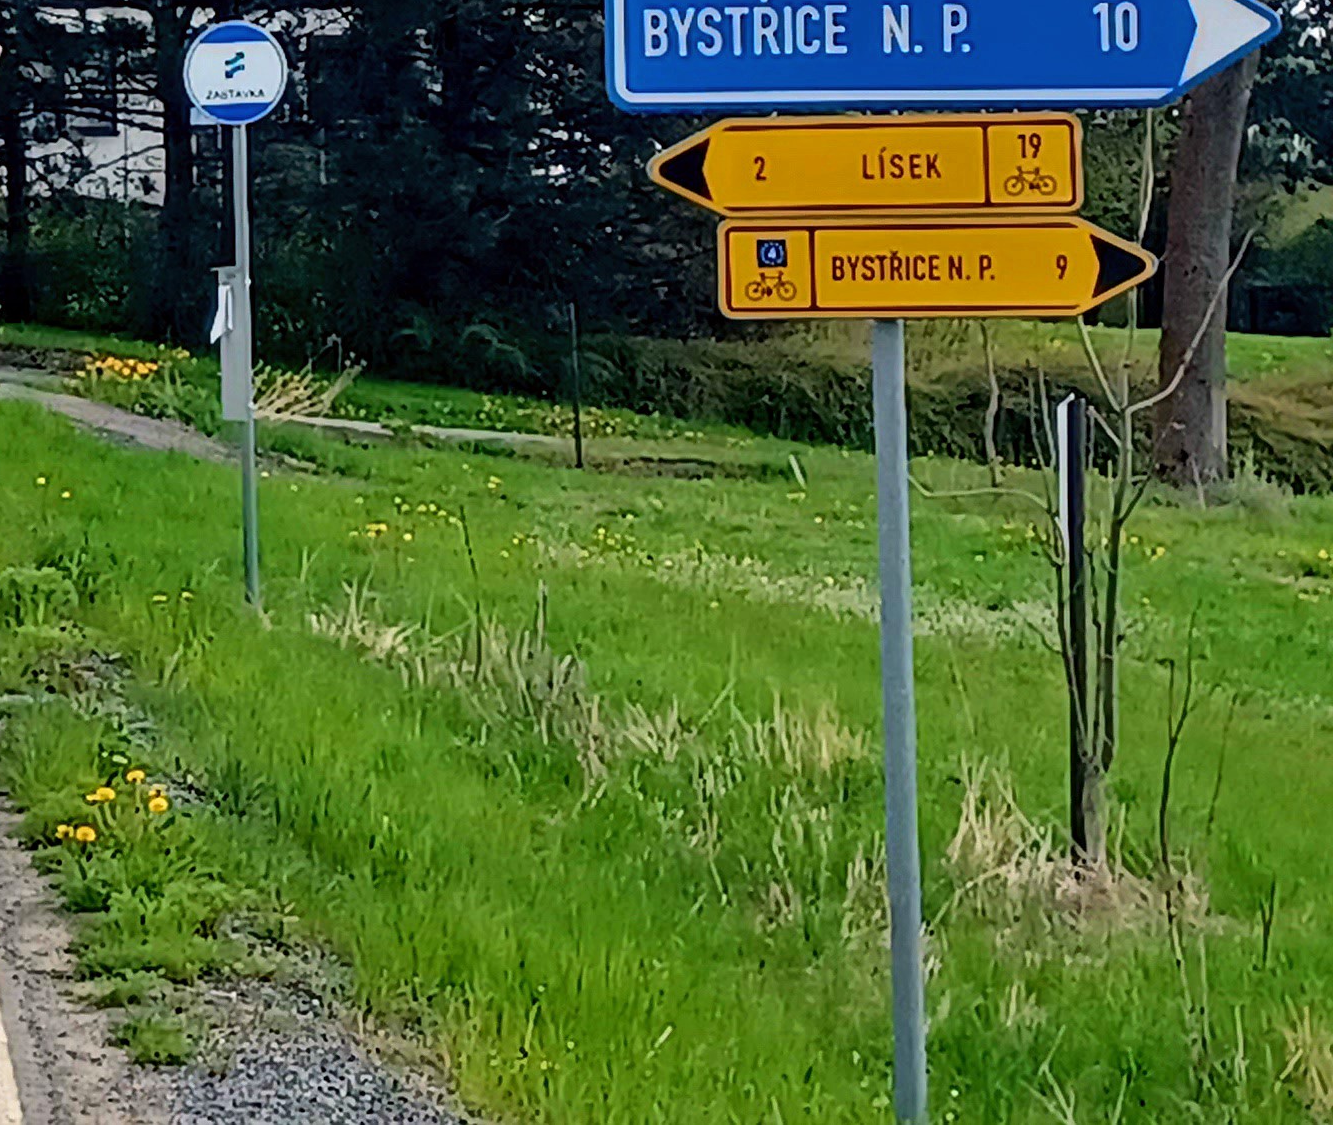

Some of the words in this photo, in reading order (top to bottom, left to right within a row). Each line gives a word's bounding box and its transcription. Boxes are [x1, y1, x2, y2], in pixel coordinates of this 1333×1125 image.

[882, 4, 923, 54] N.
[942, 3, 972, 54] P.
[1092, 0, 1139, 53] 10
[1016, 132, 1043, 160] 19
[753, 156, 768, 182] 2
[861, 146, 943, 180] LÍSEK
[831, 250, 942, 282] BYSTŘICE
[947, 257, 972, 281] N.
[978, 256, 996, 281] P.
[1055, 255, 1069, 280] 9
